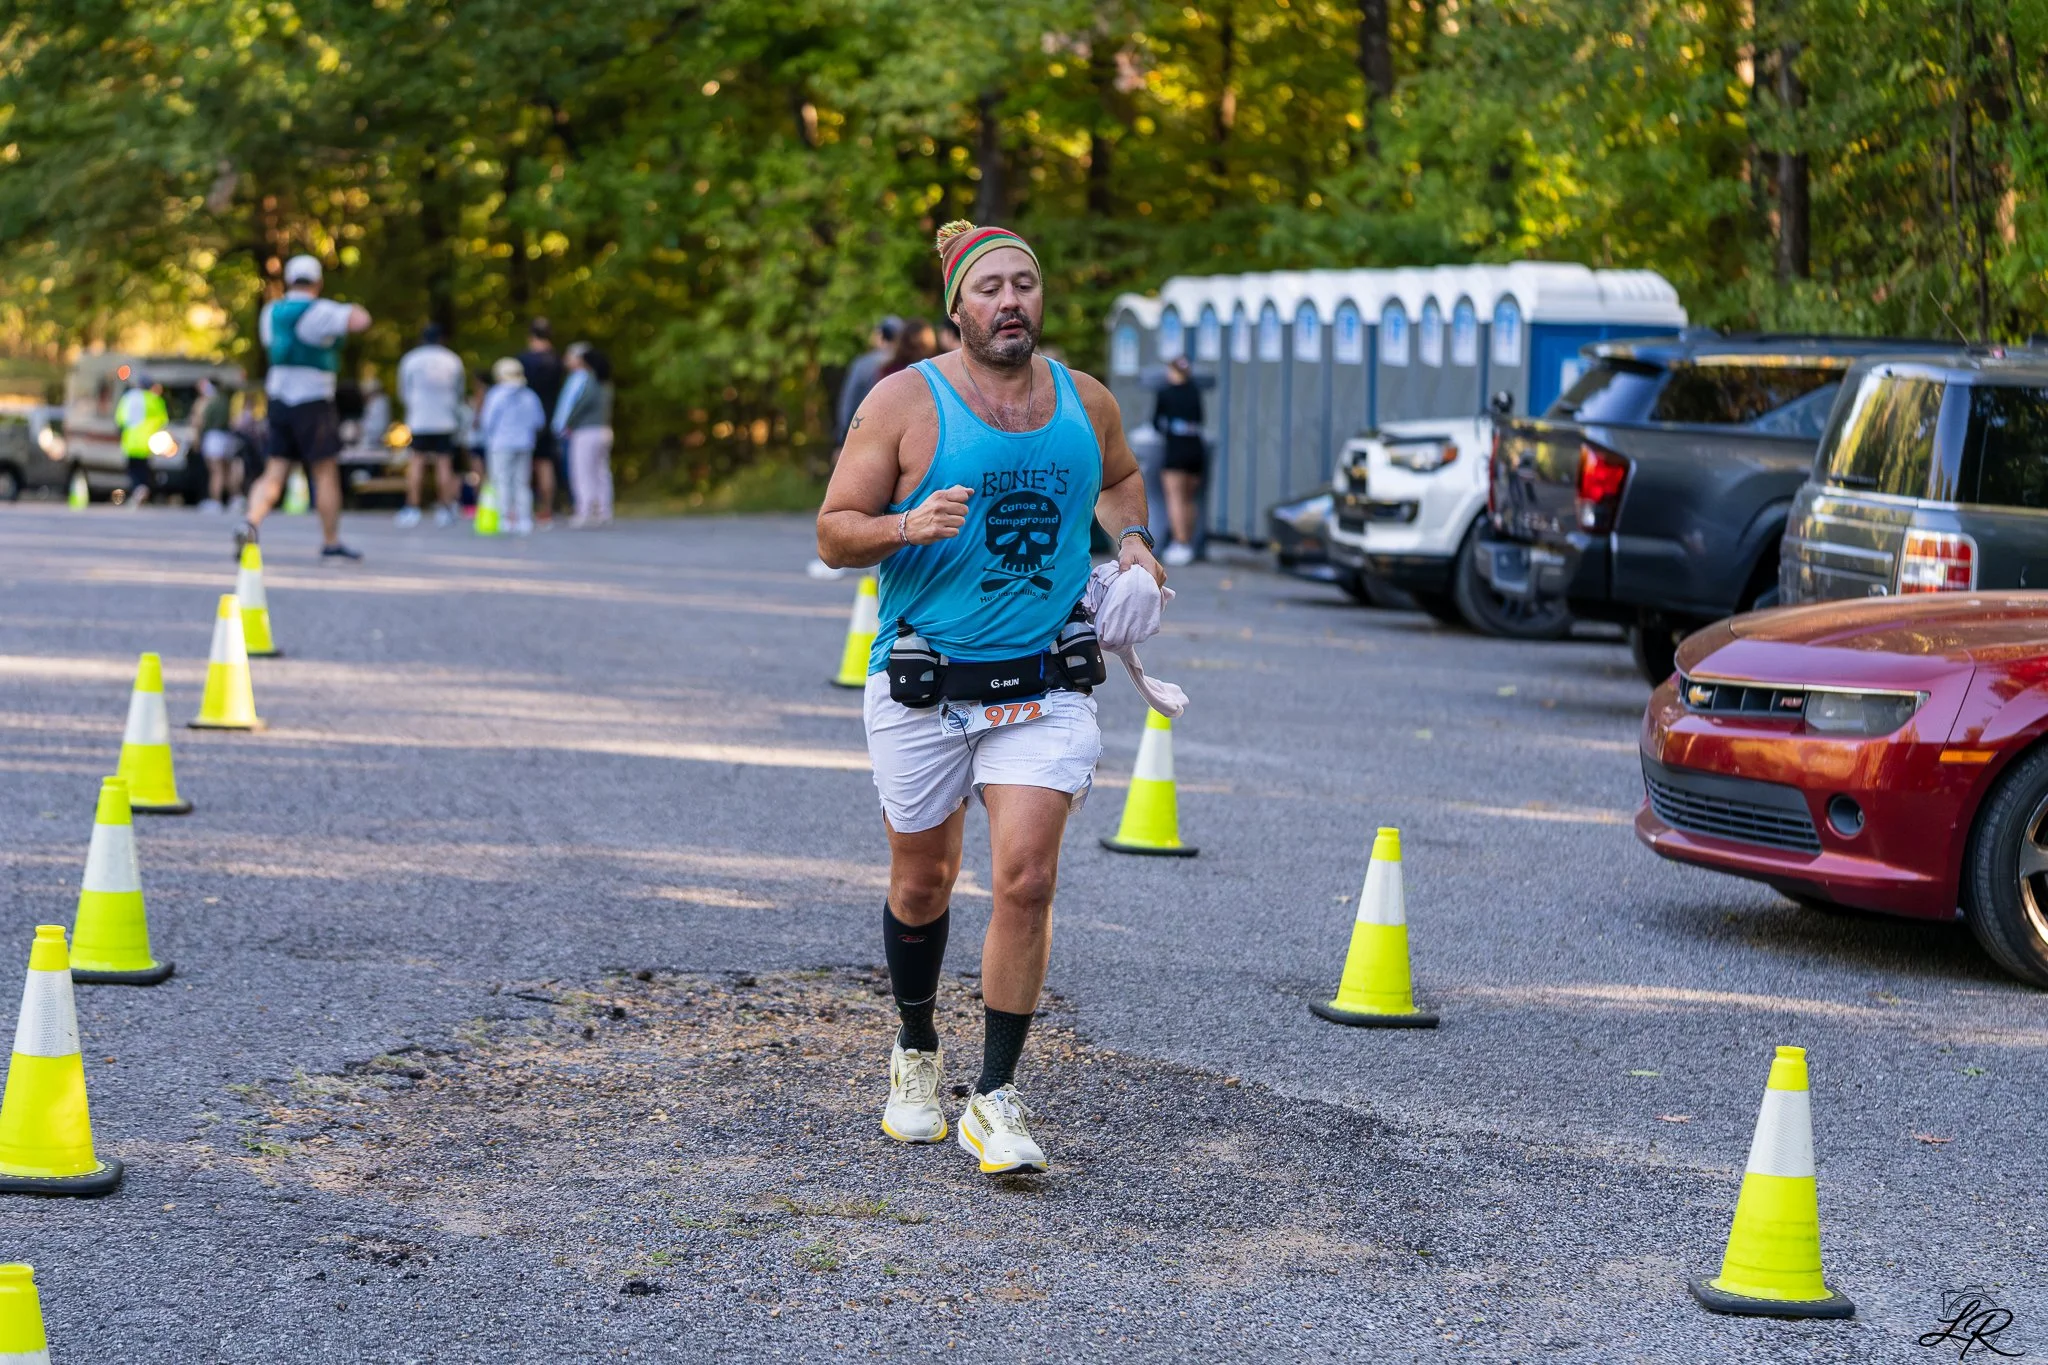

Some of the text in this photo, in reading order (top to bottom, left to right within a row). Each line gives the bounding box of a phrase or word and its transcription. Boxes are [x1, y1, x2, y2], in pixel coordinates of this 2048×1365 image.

[982, 462, 1070, 498] BONE'S
[1000, 502, 1049, 514] Canoe &
[988, 515, 1059, 527] Campground
[990, 678, 1020, 689] G-RUN
[984, 701, 1043, 728] 972
